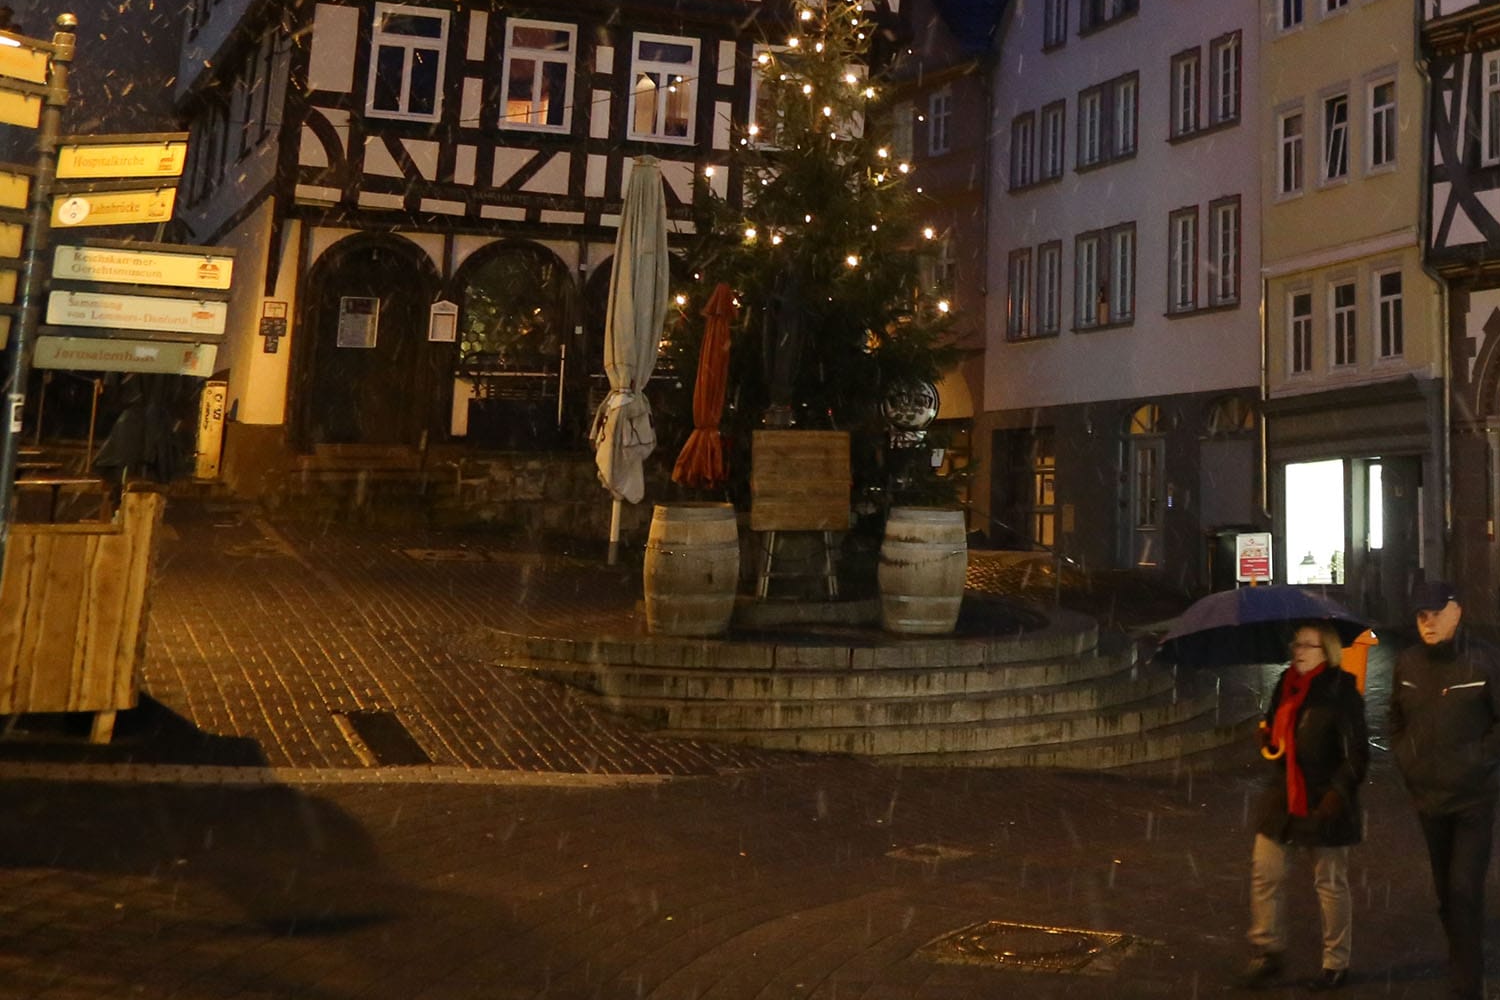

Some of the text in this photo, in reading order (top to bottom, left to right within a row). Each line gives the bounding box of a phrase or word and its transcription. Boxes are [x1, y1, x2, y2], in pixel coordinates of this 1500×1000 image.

[73, 155, 145, 168] Hospitalkirche
[89, 202, 140, 216] Lahnbrücke
[71, 264, 162, 278] Gerichtsmuseum
